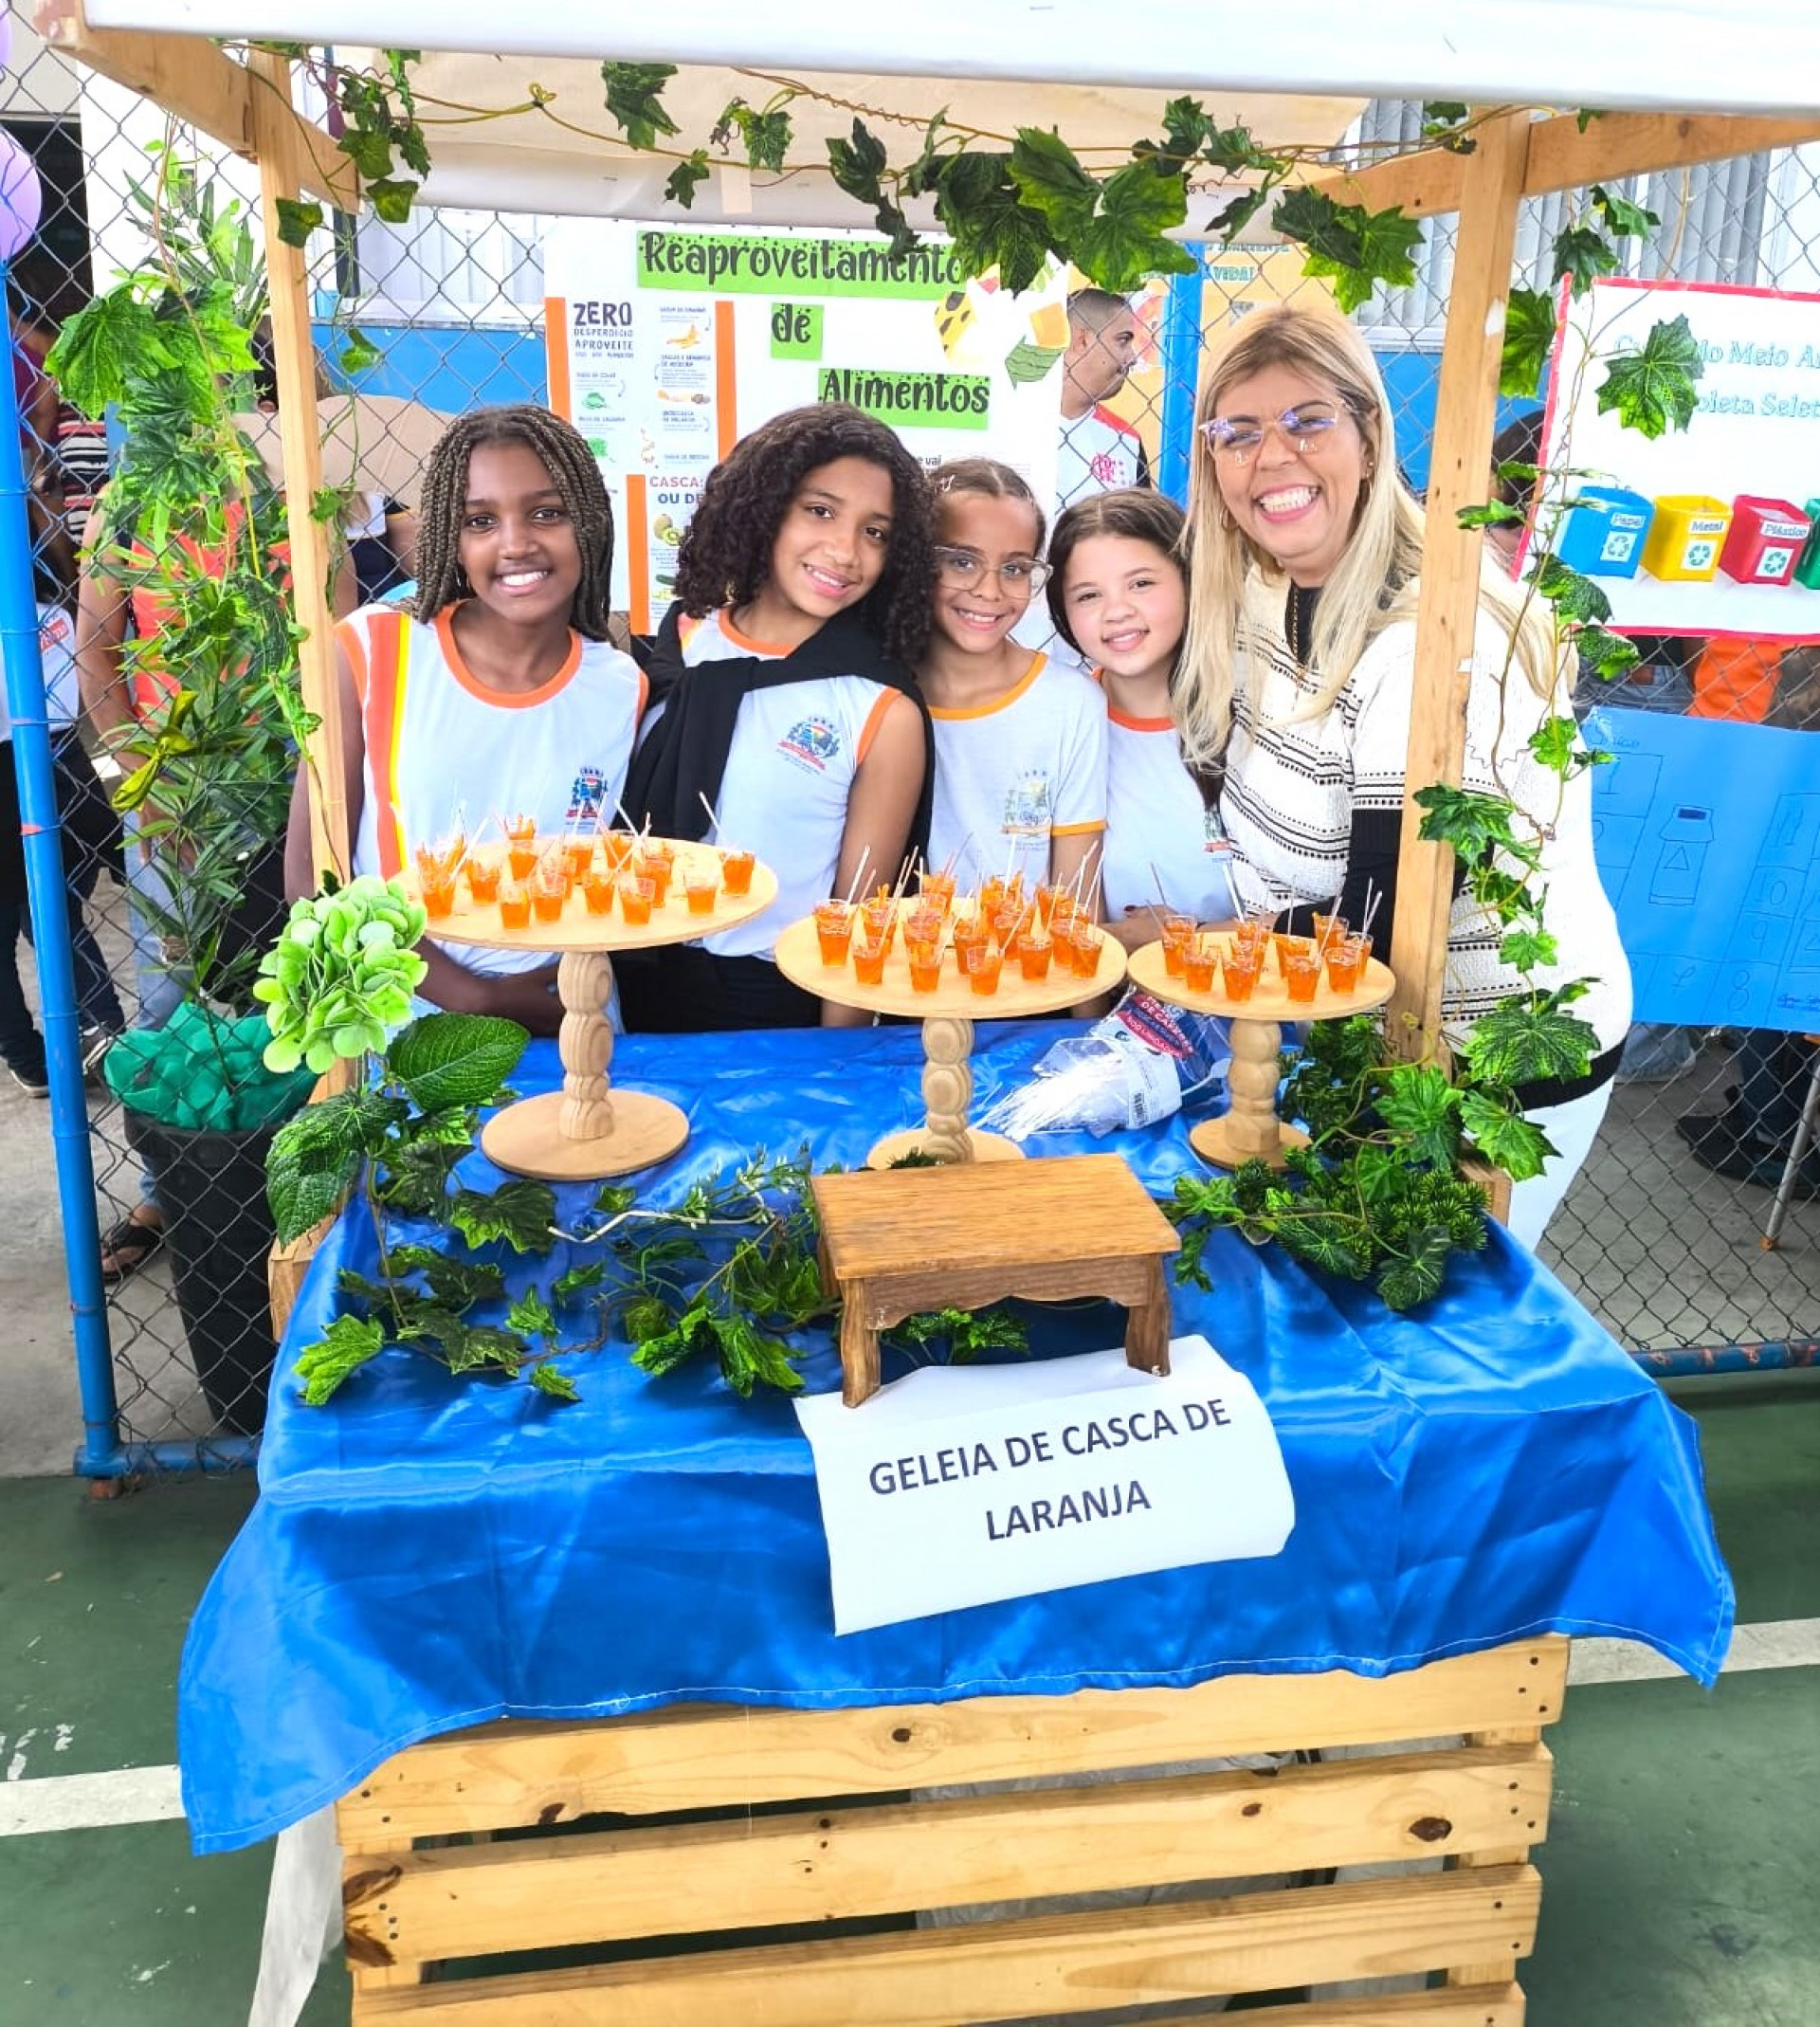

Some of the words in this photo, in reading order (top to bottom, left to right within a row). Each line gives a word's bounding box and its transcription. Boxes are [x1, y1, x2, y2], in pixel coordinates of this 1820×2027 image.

[573, 301, 632, 327] ZERO
[772, 303, 811, 343] de
[574, 338, 633, 351] APROVEITE
[1729, 341, 1789, 367] Meio
[823, 369, 990, 413] Alimentos
[658, 493, 680, 503] OU
[1692, 521, 1722, 532] Metal
[869, 1442, 998, 1496] GELEIA
[1005, 1432, 1054, 1469] DE
[1061, 1408, 1178, 1455] CASCA
[1182, 1398, 1231, 1433] DE
[985, 1479, 1152, 1542] LARANJA
